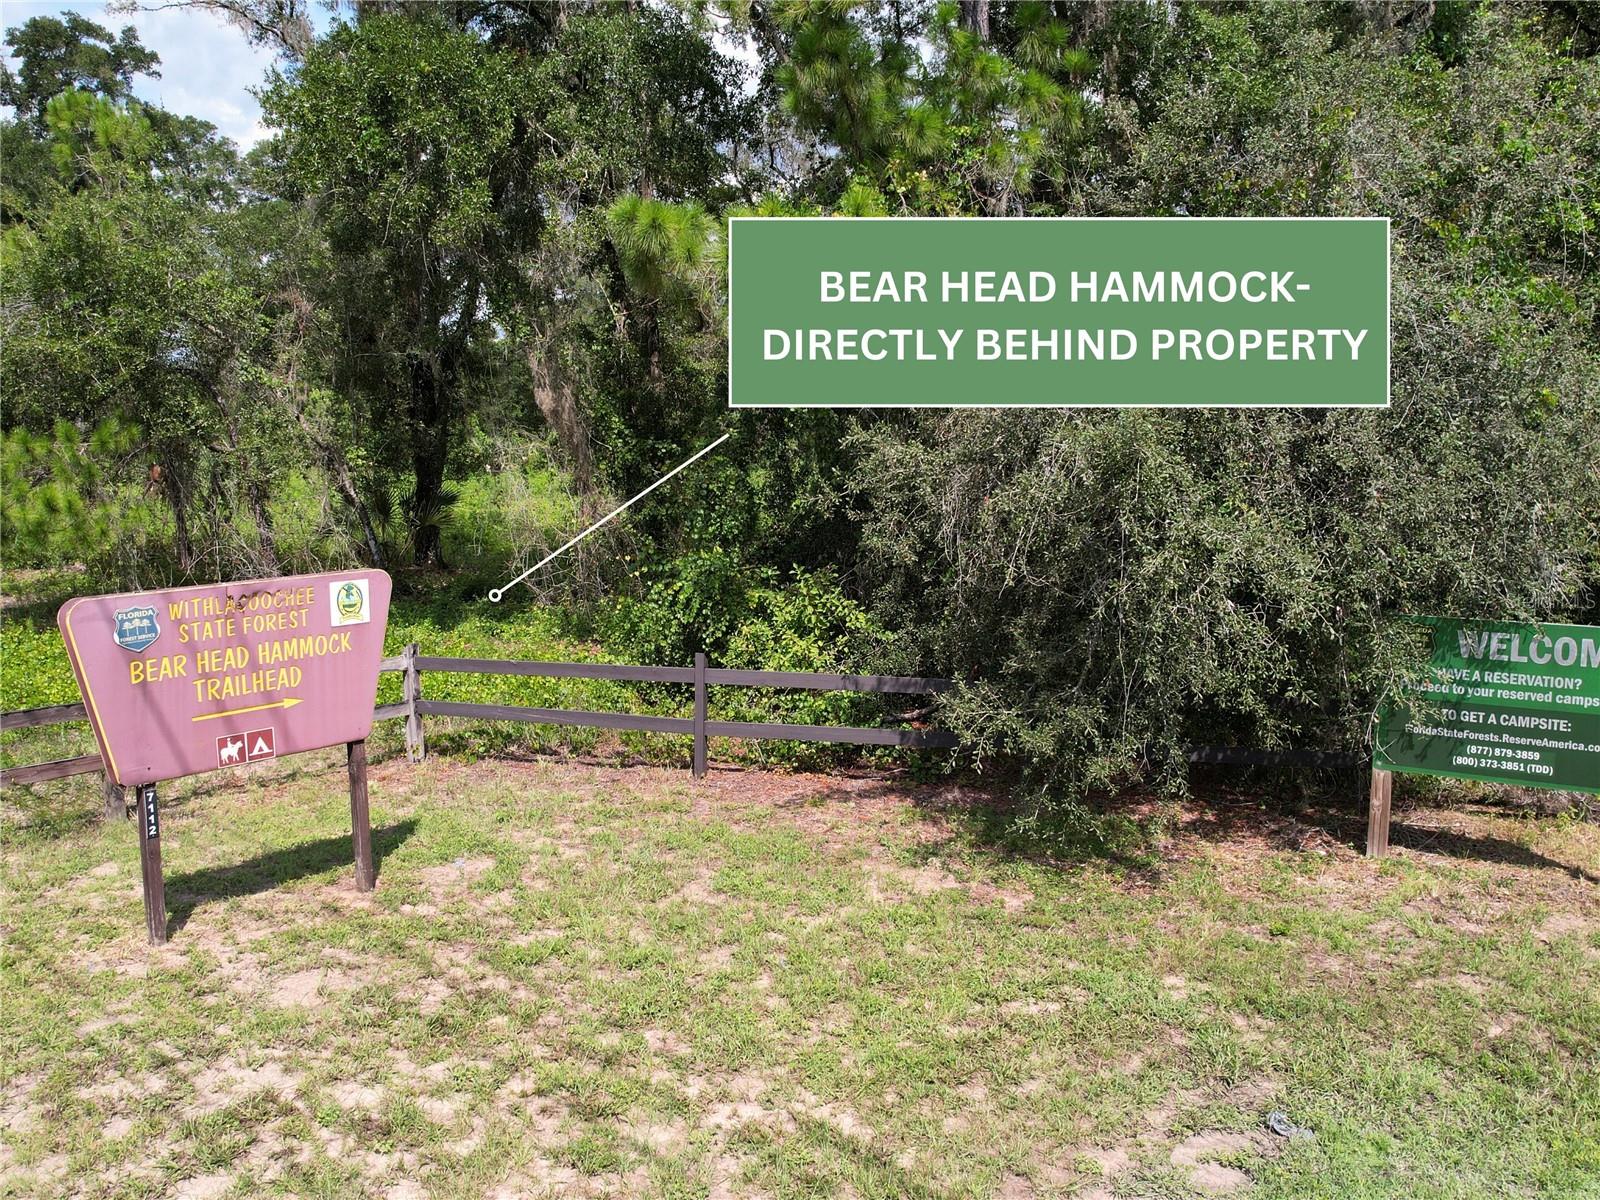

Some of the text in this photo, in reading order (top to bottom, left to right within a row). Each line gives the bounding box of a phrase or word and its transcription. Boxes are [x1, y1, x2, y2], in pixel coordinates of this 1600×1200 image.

[118, 609, 154, 621] FLORIDA
[168, 586, 316, 621] WITHLACOOCHEE
[178, 608, 309, 643] STATE FOREST
[129, 631, 352, 684] BEAR HEAD HAMMOCK
[192, 665, 302, 702] TRAILHEAD
[1437, 667, 1583, 690] HAVE A RESERVATION?
[1452, 683, 1465, 695] to
[1467, 686, 1495, 698] your
[1497, 689, 1553, 703] reserved
[1555, 693, 1600, 708] camps
[1440, 708, 1572, 732] TO GET A CAMPSITE:
[1466, 745, 1541, 761] (877) 879-3859
[1452, 755, 1554, 777] (800) 373-3851 (TDD)
[146, 792, 157, 835] 7112
